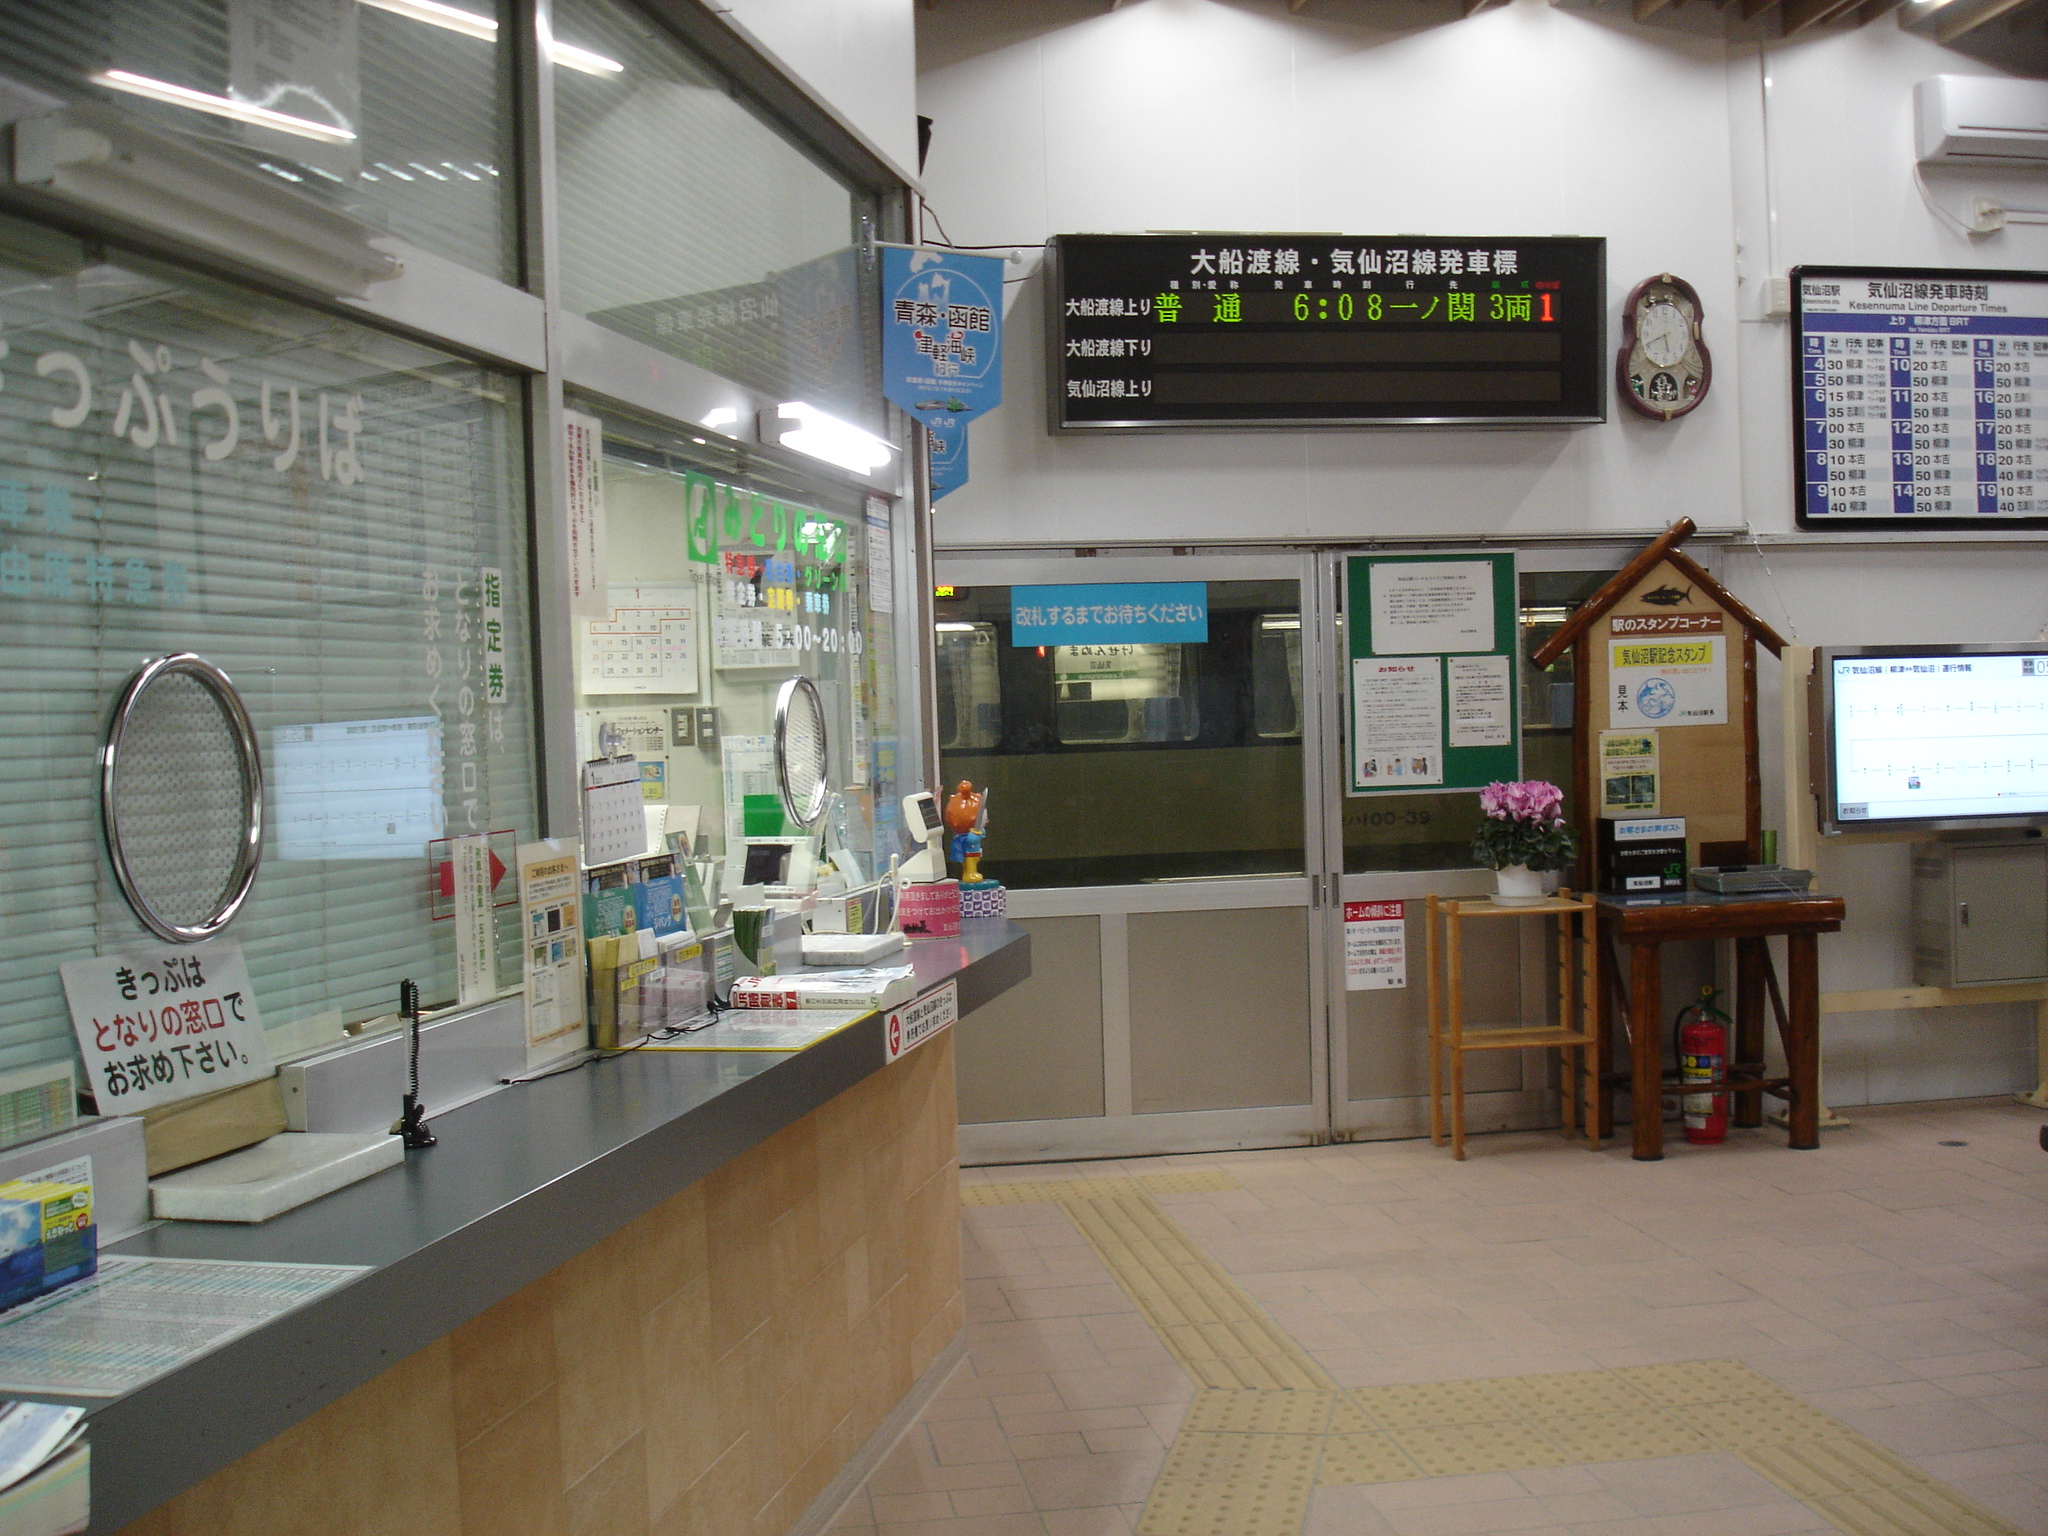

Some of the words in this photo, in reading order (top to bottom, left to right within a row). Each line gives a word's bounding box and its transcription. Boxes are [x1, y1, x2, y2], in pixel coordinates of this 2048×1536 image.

[1190, 248, 1519, 276] 大船渡線・気仙沼線発車標
[1802, 284, 1841, 297] 気仙沼駅
[1868, 281, 1988, 301] 気仙沼線発車時刻
[894, 299, 991, 332] 青森・函館
[1065, 298, 1151, 317] 大船渡線上り
[1294, 293, 1383, 321] 6:08
[1389, 292, 1475, 322] 一ノ関
[1489, 293, 1533, 322] 3両
[1540, 293, 1555, 322] 1
[1849, 301, 1906, 311] Kesennuma
[1908, 301, 1929, 311] Line
[1931, 303, 1977, 314] Departure
[1980, 304, 2008, 314] Times
[1949, 317, 1970, 327] BRT
[915, 330, 976, 366] 津軽海峡
[1065, 339, 1152, 357] 大船渡線下り
[1814, 358, 1825, 370] 4
[1827, 360, 1843, 370] 30
[1891, 358, 1910, 371] 10
[1912, 361, 1928, 371] 20
[1931, 360, 1948, 370] 本吉
[1975, 359, 1993, 372] 15
[1996, 363, 2011, 372] 20
[2014, 362, 2030, 371] 本吉
[1066, 379, 1152, 398] 気仙沼線上り
[1815, 374, 1825, 386] 5
[1827, 376, 1843, 385] 50
[1913, 377, 1929, 386] 50
[1996, 378, 2011, 388] 50
[1815, 390, 1826, 402] 6
[1828, 392, 1844, 402] 15
[1892, 390, 1911, 403] 11
[1913, 393, 1929, 402] 20
[1932, 392, 1949, 401] 本吉
[1976, 391, 1994, 403] 16
[1997, 393, 2012, 403] 20
[1828, 408, 1844, 417] 35
[1914, 408, 1929, 418] 50
[1997, 409, 2012, 418] 50
[1816, 421, 1826, 433] 7
[1828, 423, 1845, 433] 00
[1848, 422, 1866, 432] 本吉
[1893, 422, 1912, 434] 12
[1914, 424, 1930, 434] 20
[1932, 423, 1950, 433] 本吉
[1976, 422, 1994, 434] 17
[1997, 425, 2012, 434] 20
[2015, 424, 2032, 433] 本吉
[1829, 439, 1845, 449] 30
[1914, 440, 1930, 449] 50
[1998, 440, 2013, 450] 50
[1816, 453, 1827, 465] 8
[1829, 455, 1845, 465] 10
[1848, 454, 1866, 463] 本吉
[1894, 453, 1913, 465] 13
[1915, 455, 1931, 465] 20
[1933, 454, 1951, 464] 本吉
[1977, 454, 1995, 465] 18
[1998, 455, 2013, 465] 20
[2016, 454, 2033, 464] 本吉
[1830, 471, 1846, 481] 50
[1915, 471, 1931, 481] 50
[1998, 471, 2014, 481] 40
[1817, 485, 1828, 497] 9
[1830, 487, 1846, 496] 10
[1849, 486, 1867, 495] 本吉
[1894, 485, 1913, 497] 14
[1915, 487, 1931, 496] 20
[1934, 486, 1951, 495] 本吉
[1979, 484, 1996, 497] 19
[1999, 486, 2014, 496] 10
[2017, 486, 2033, 495] 本吉
[1830, 503, 1847, 512] 40
[1916, 503, 1932, 512] 50
[1999, 503, 2014, 512] 40
[1015, 602, 1203, 627] 改札するまでお待ちください
[1611, 616, 1722, 633] 駅のスタンプコーナー
[1622, 644, 1707, 666] 気仙沼駅記念スタンプ
[1617, 684, 1629, 713] 見本
[1663, 862, 1682, 875] JR
[115, 955, 206, 1002] きっぷは
[92, 990, 247, 1053] となりの窓口で
[104, 1038, 250, 1098] お求め下さい。
